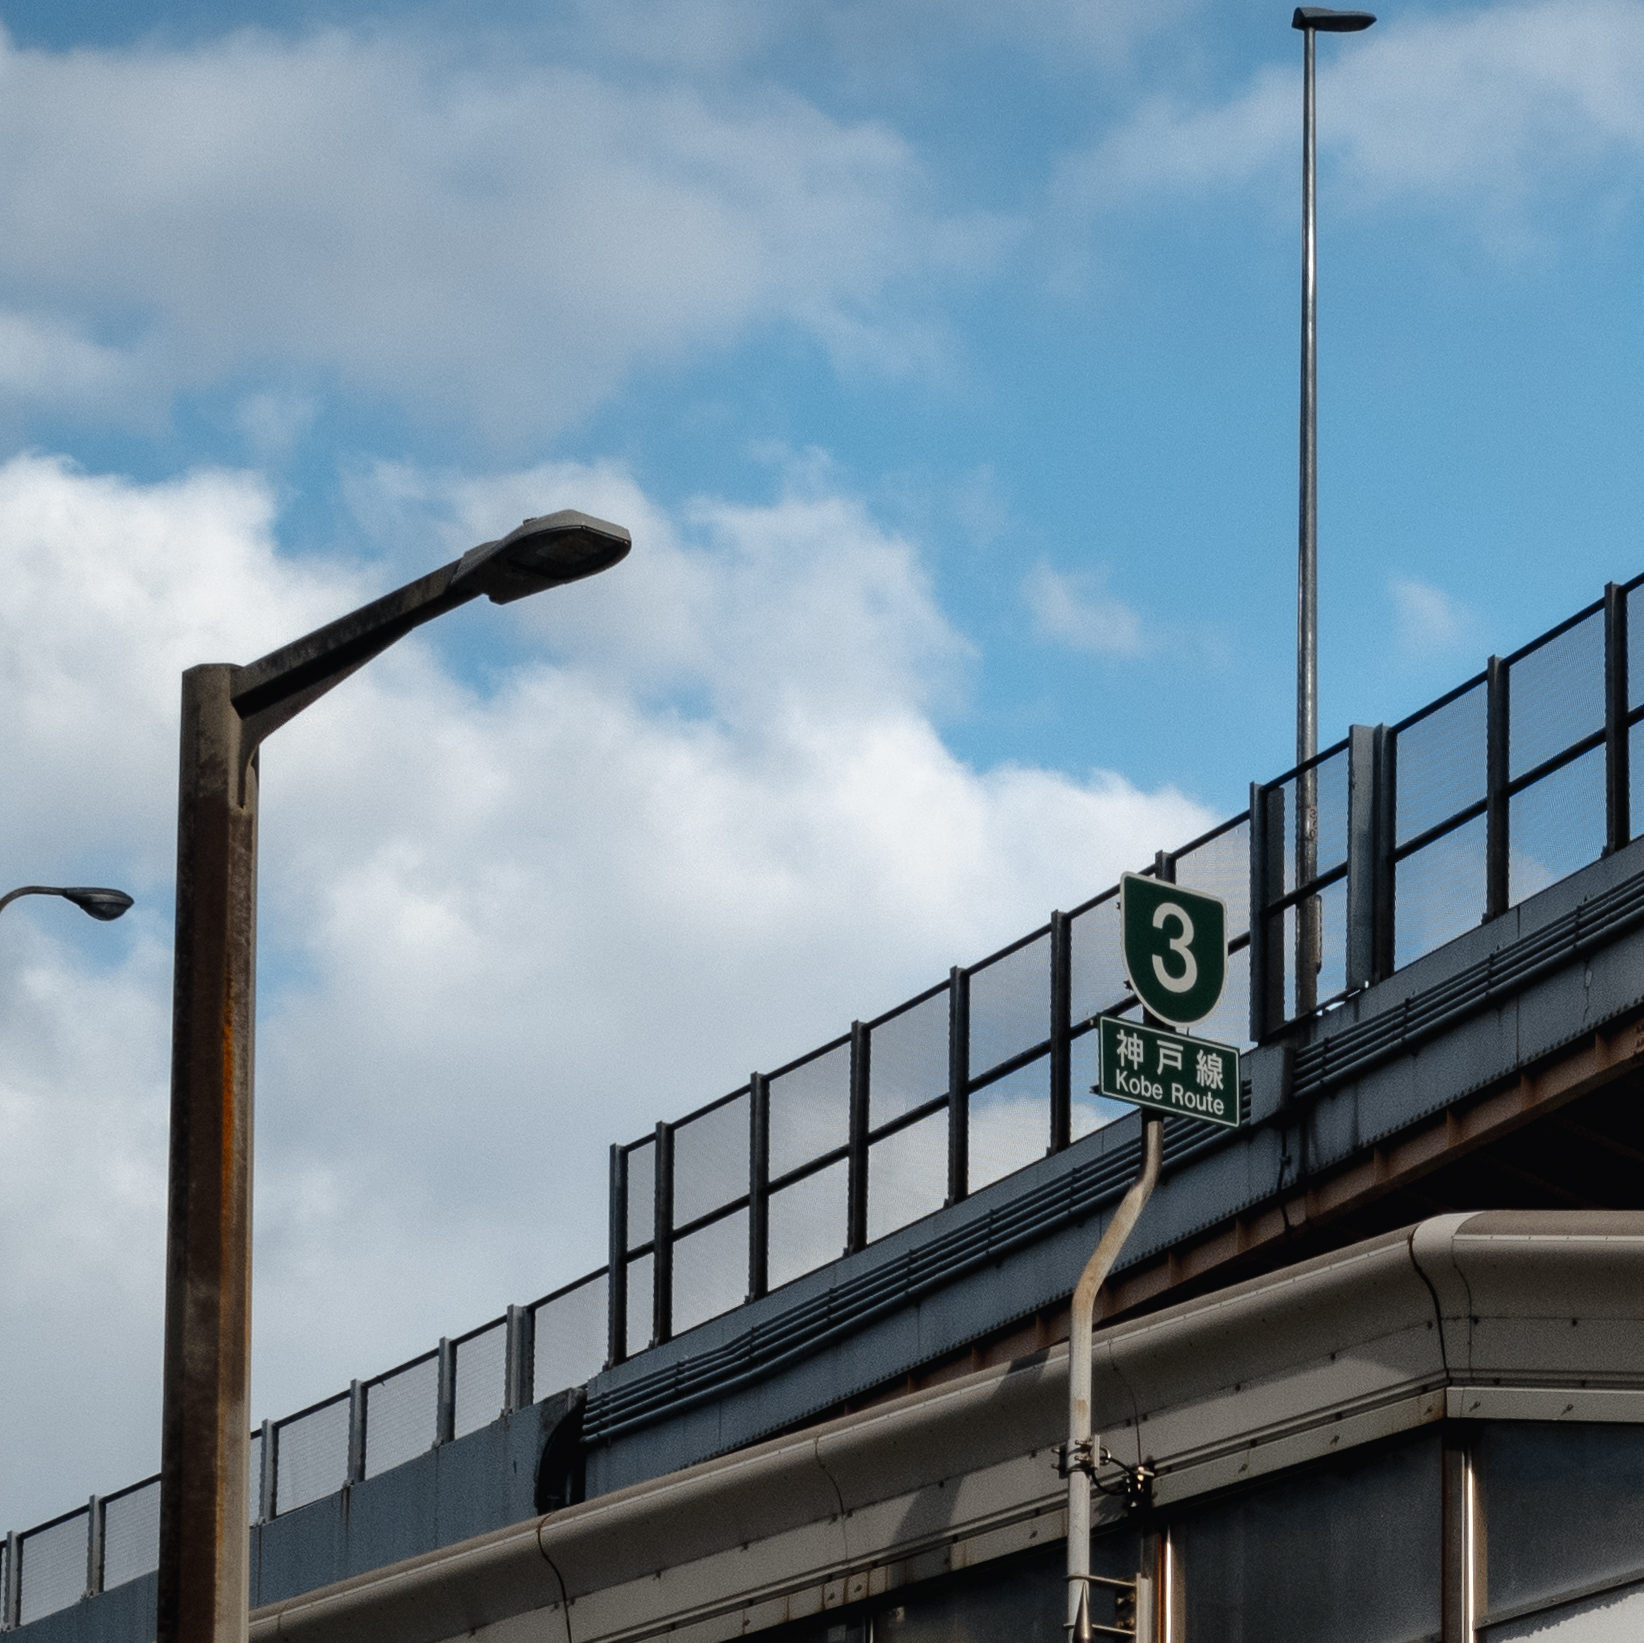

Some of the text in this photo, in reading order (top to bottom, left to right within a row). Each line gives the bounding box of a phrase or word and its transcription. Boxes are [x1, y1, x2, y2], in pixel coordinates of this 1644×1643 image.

[1152, 902, 1198, 993] 3
[1116, 1029, 1224, 1090] 神戸線
[1116, 1068, 1224, 1115] Kobe Route
